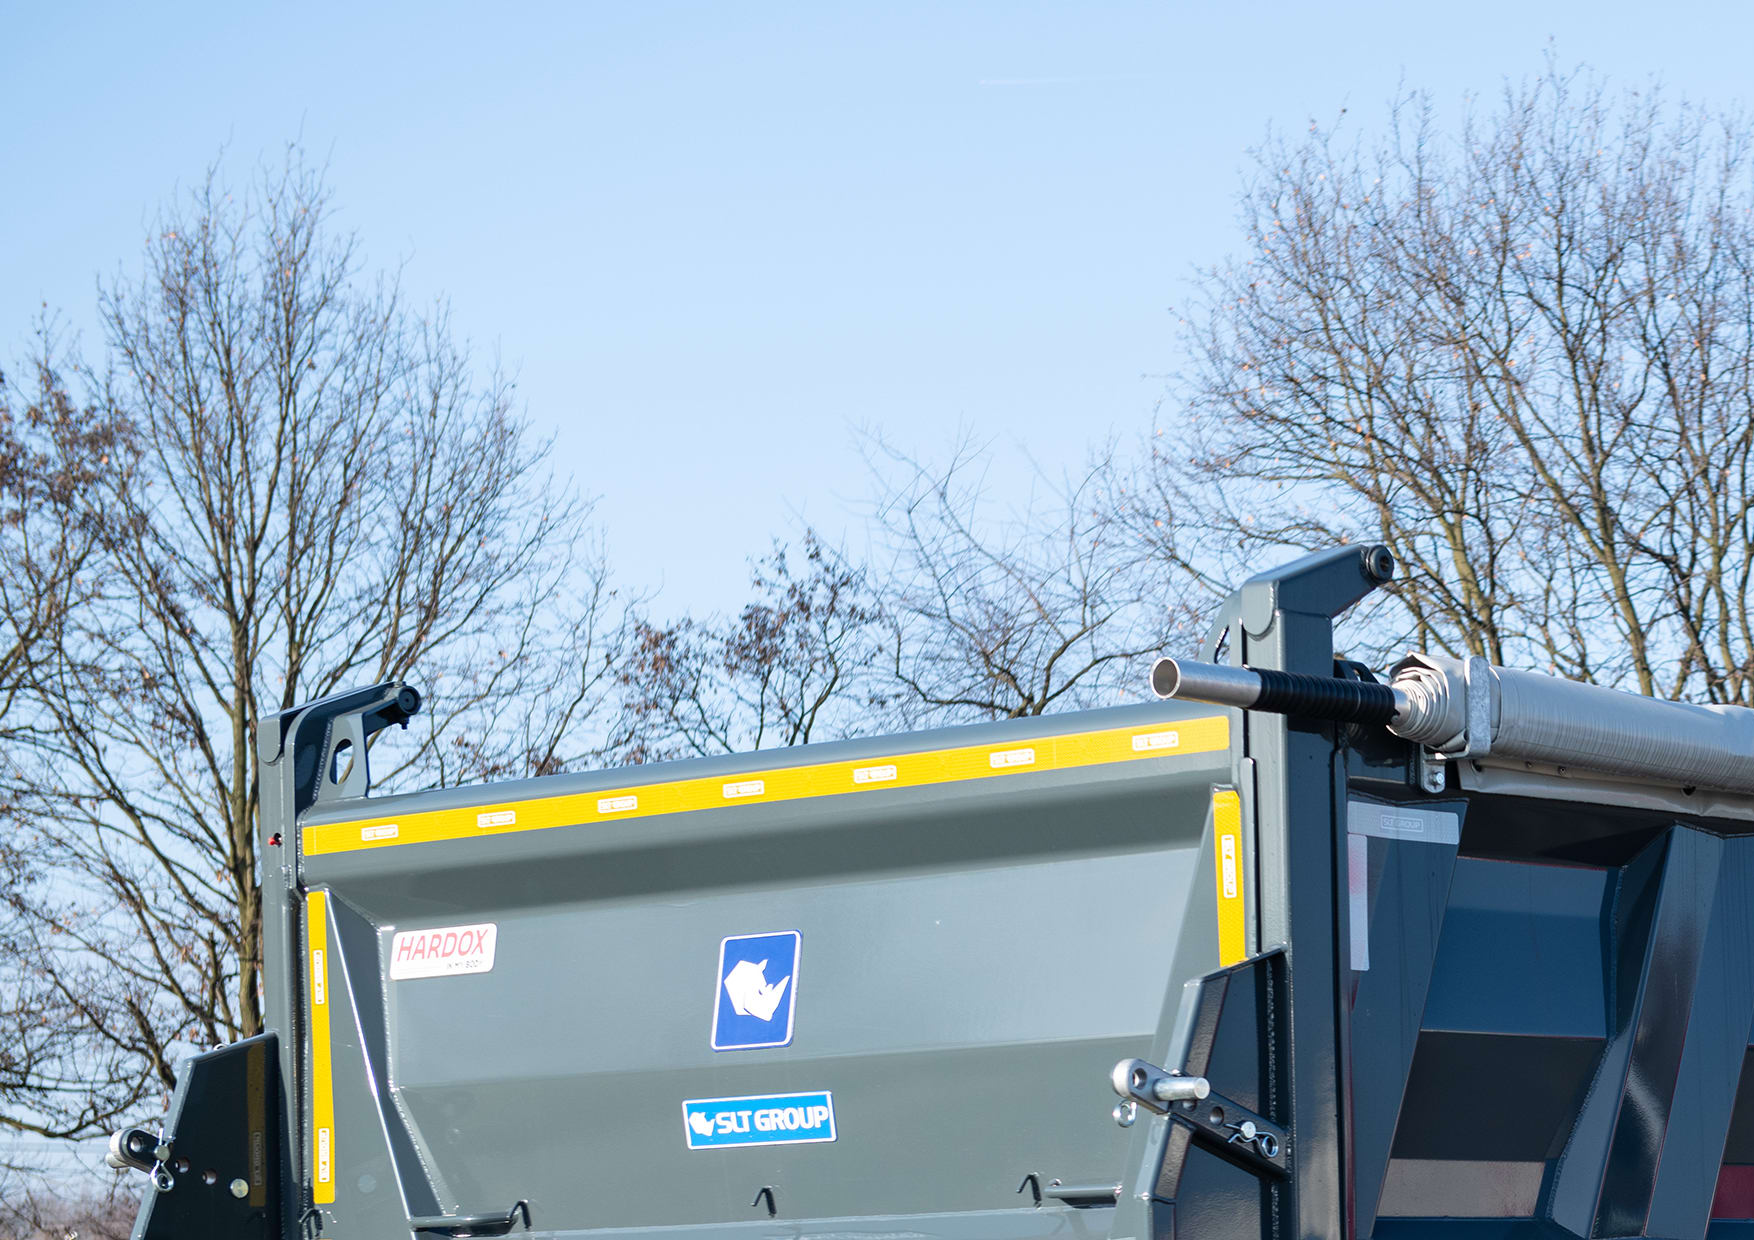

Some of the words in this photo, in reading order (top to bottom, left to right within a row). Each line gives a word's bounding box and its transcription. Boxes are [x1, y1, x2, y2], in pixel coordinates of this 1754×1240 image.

[397, 929, 489, 962] HARDOX
[715, 1110, 752, 1134] SLT
[754, 1105, 829, 1132] GROUP
